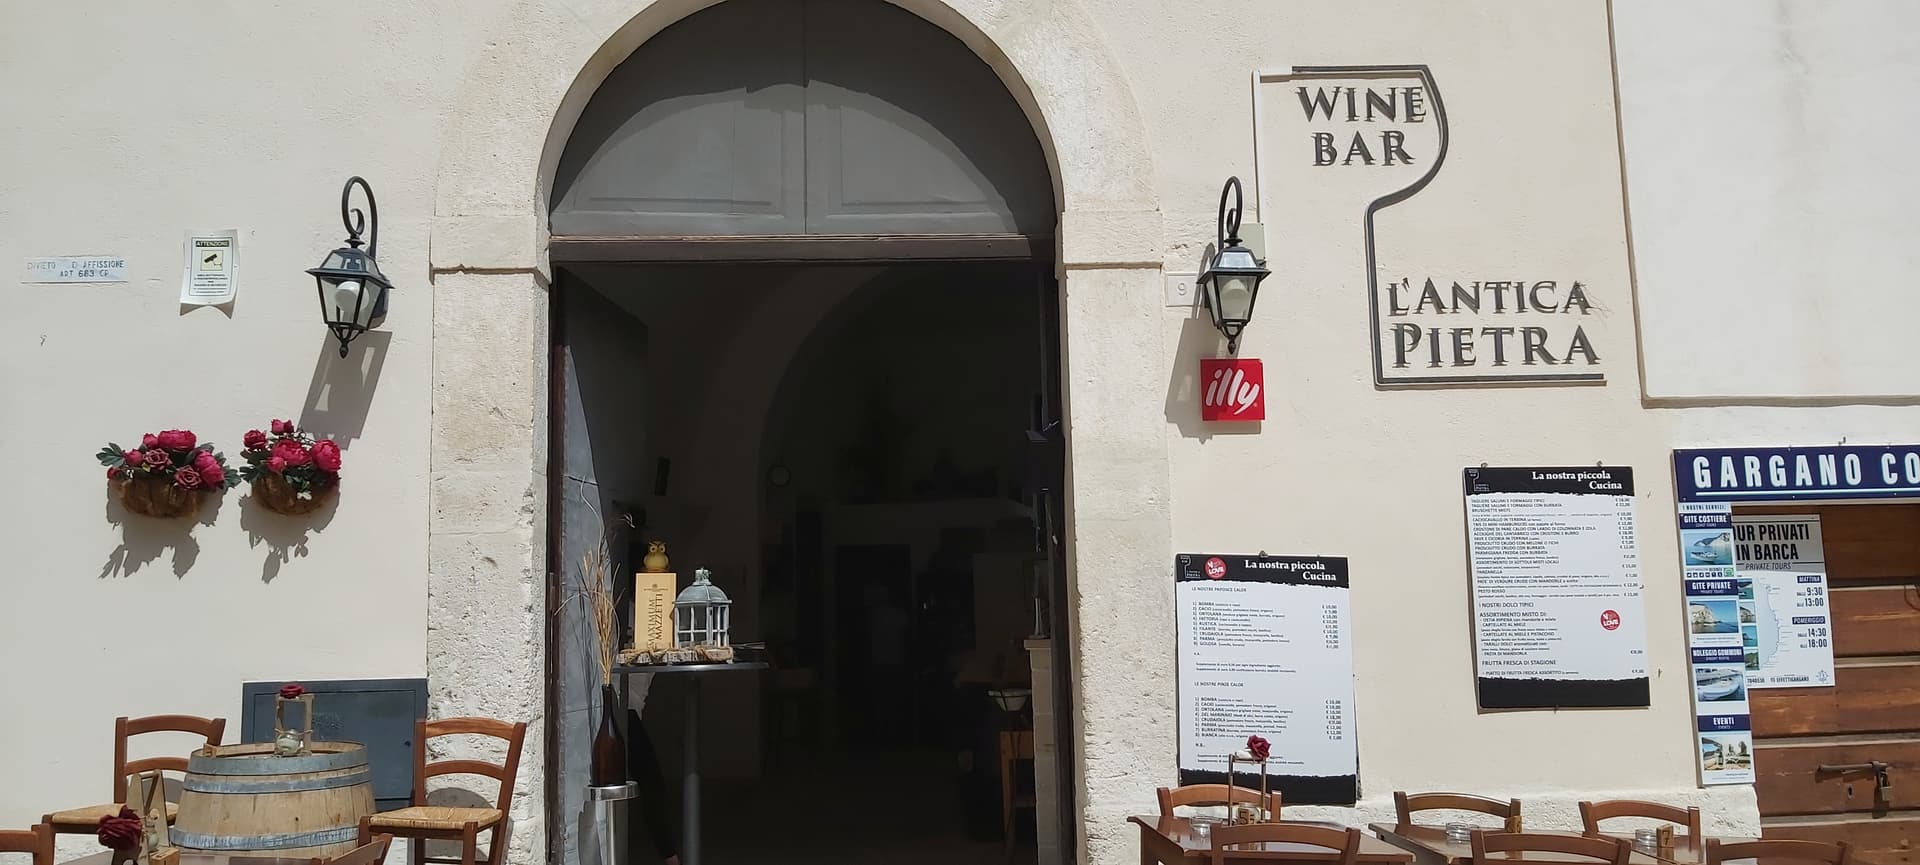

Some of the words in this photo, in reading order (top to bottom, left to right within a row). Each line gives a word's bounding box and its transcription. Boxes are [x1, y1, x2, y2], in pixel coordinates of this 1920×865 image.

[1295, 86, 1428, 123] WINE
[1311, 130, 1416, 166] BAR
[1386, 277, 1594, 316] L'ANTICA
[1391, 323, 1600, 368] PIETRA
[1205, 368, 1260, 415] illy
[1532, 471, 1544, 480] La
[1546, 472, 1576, 480] nostra
[1577, 470, 1611, 482] piccola
[1692, 453, 1862, 488] GARGANO
[1589, 481, 1623, 490] Cucina
[1758, 523, 1810, 541] PRIVATI
[1736, 543, 1751, 561] IN
[1753, 543, 1800, 561] BARCA
[1244, 559, 1257, 569] La
[1258, 560, 1289, 570] nostra
[1291, 560, 1325, 572] piccola
[1745, 562, 1770, 571] PRIVATE
[1771, 561, 1792, 570] TOURS
[1302, 571, 1336, 581] Cucina
[1707, 581, 1732, 590] PRIVATE
[1806, 587, 1823, 596] 9:30
[1804, 597, 1824, 607] 13:00
[655, 593, 663, 641] MAZZETTI
[1808, 628, 1827, 637] 14:30
[1808, 639, 1828, 648] 18:00
[1713, 717, 1735, 725] EVENTI
